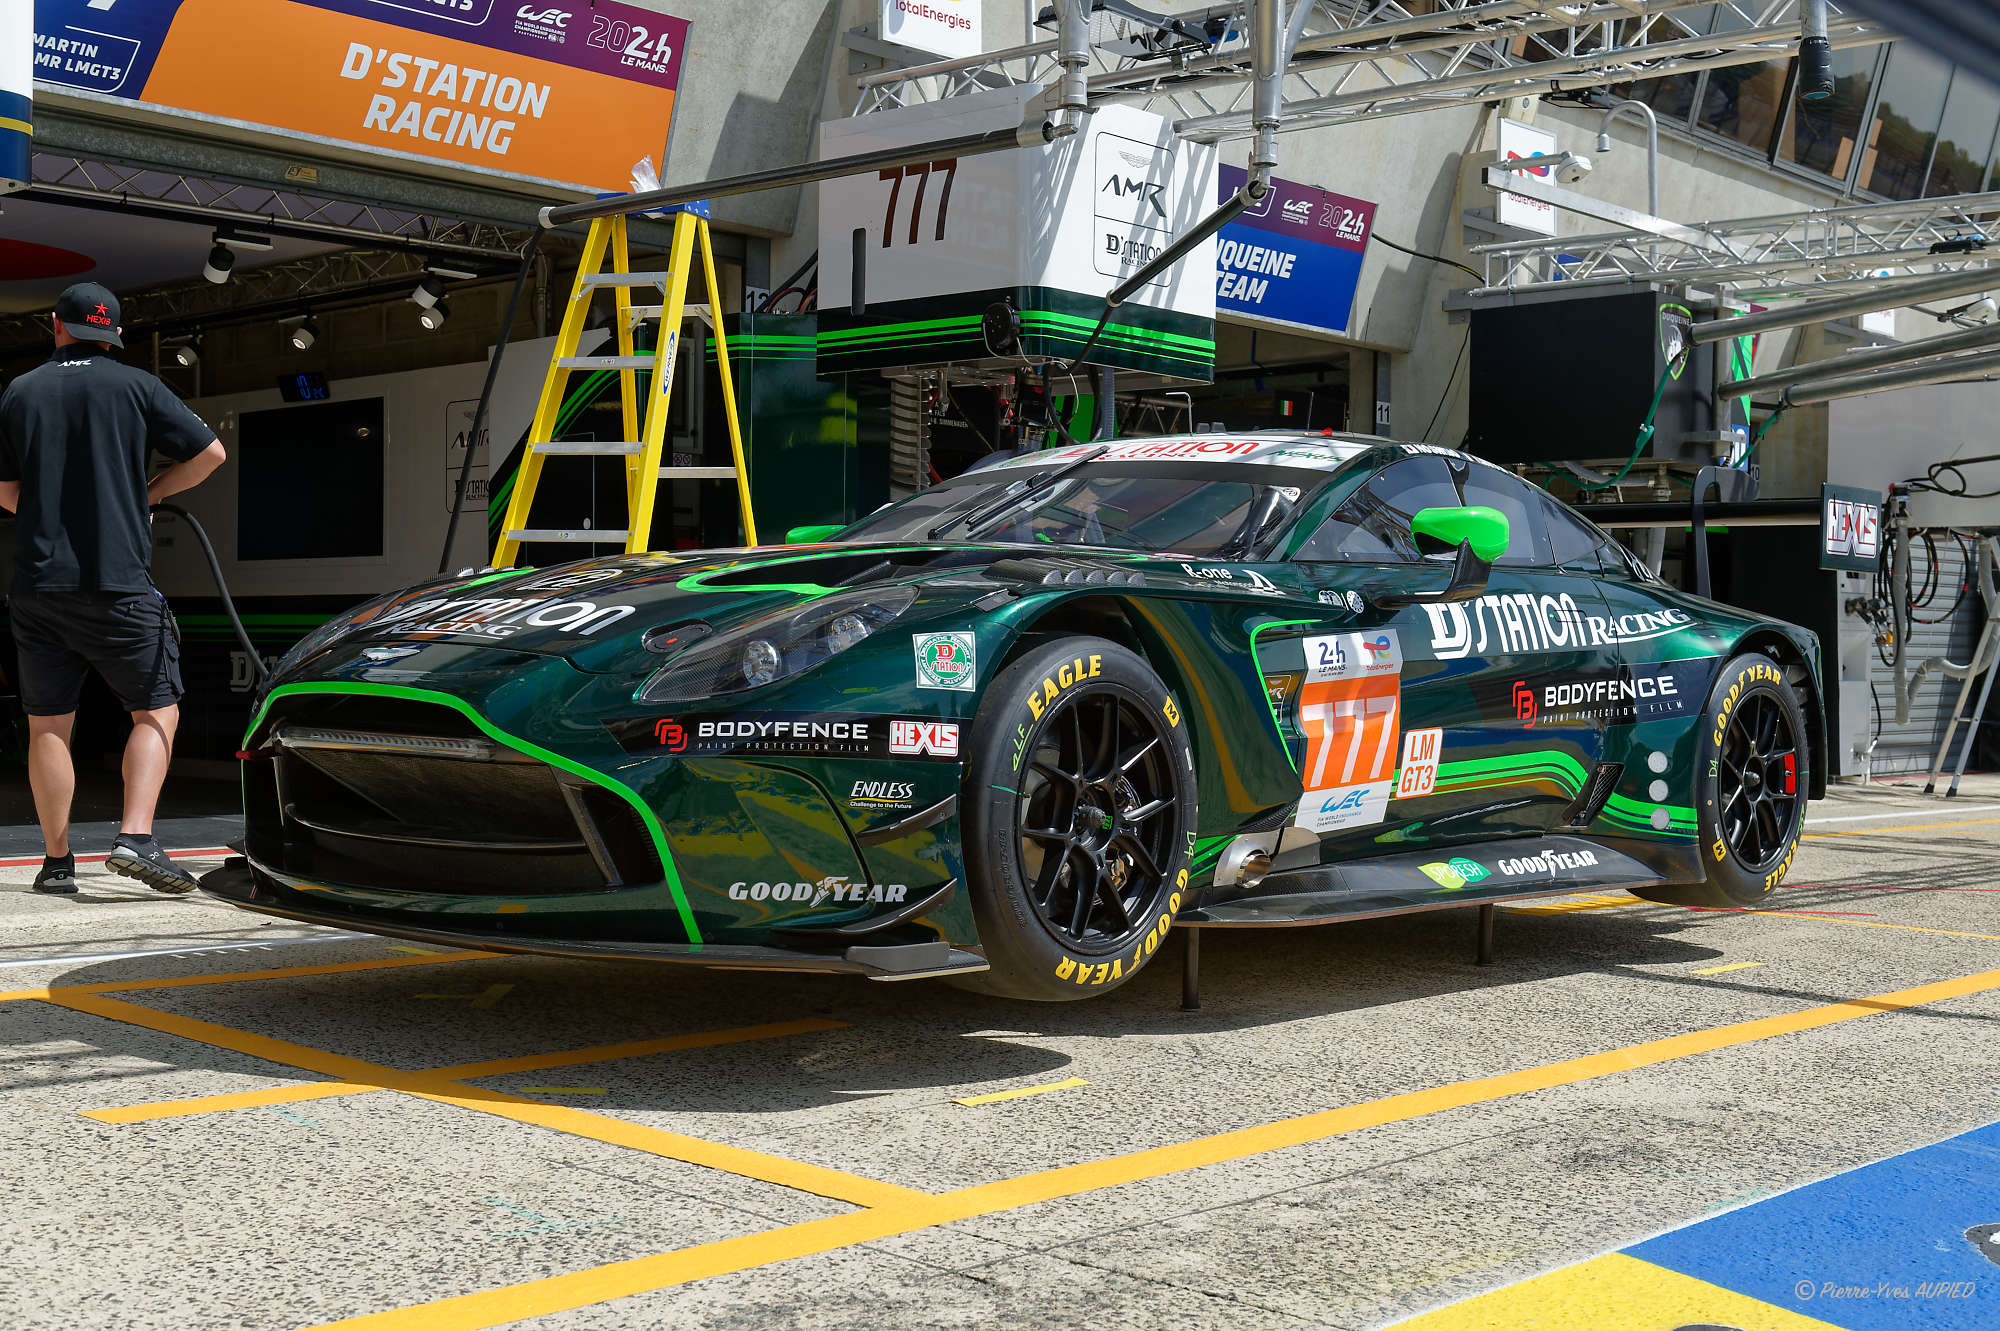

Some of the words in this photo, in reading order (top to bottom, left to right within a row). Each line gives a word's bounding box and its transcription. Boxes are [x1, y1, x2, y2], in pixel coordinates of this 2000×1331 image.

[517, 4, 573, 28] WEC
[33, 33, 99, 58] MARTIN
[65, 58, 122, 80] LMGT3
[621, 55, 635, 67] LE
[635, 60, 667, 74] MANS
[340, 41, 551, 119] D'STATION
[363, 93, 516, 155] RACING
[879, 158, 957, 248] 777
[1102, 174, 1167, 218] AMR
[1283, 199, 1314, 215] WEC
[86, 314, 111, 326] HEXIS
[1378, 404, 1390, 423] 11
[1827, 501, 1877, 552] HEXIS
[1181, 563, 1233, 580] R-one
[1420, 592, 1588, 661] D'STATION
[1586, 608, 1691, 646] RACING
[930, 661, 964, 673] STATION
[1328, 664, 1348, 672] MANS
[1027, 654, 1102, 721] EAGLE
[1544, 675, 1678, 708] BODYFENCE
[1543, 713, 1569, 724] PAINT
[1575, 706, 1638, 719] PROTECTION
[1650, 701, 1683, 713] FILM
[1713, 664, 1782, 747] GOODYEAR
[698, 721, 869, 740] BODYFENCE
[892, 722, 958, 753] HEXIS
[698, 742, 736, 750] PAINT
[746, 743, 829, 751] PROTECTION
[840, 743, 869, 752] FILM
[1301, 695, 1397, 788] 777
[1410, 733, 1435, 761] LM
[1401, 765, 1433, 793] GT3
[1708, 758, 1718, 778] D4
[851, 780, 915, 799] ENDLESS
[1320, 789, 1370, 813] WEC
[1498, 850, 1599, 876] GOODYEAR
[728, 879, 908, 905] GOODYEAR
[1055, 868, 1189, 985] GOODYEAR
